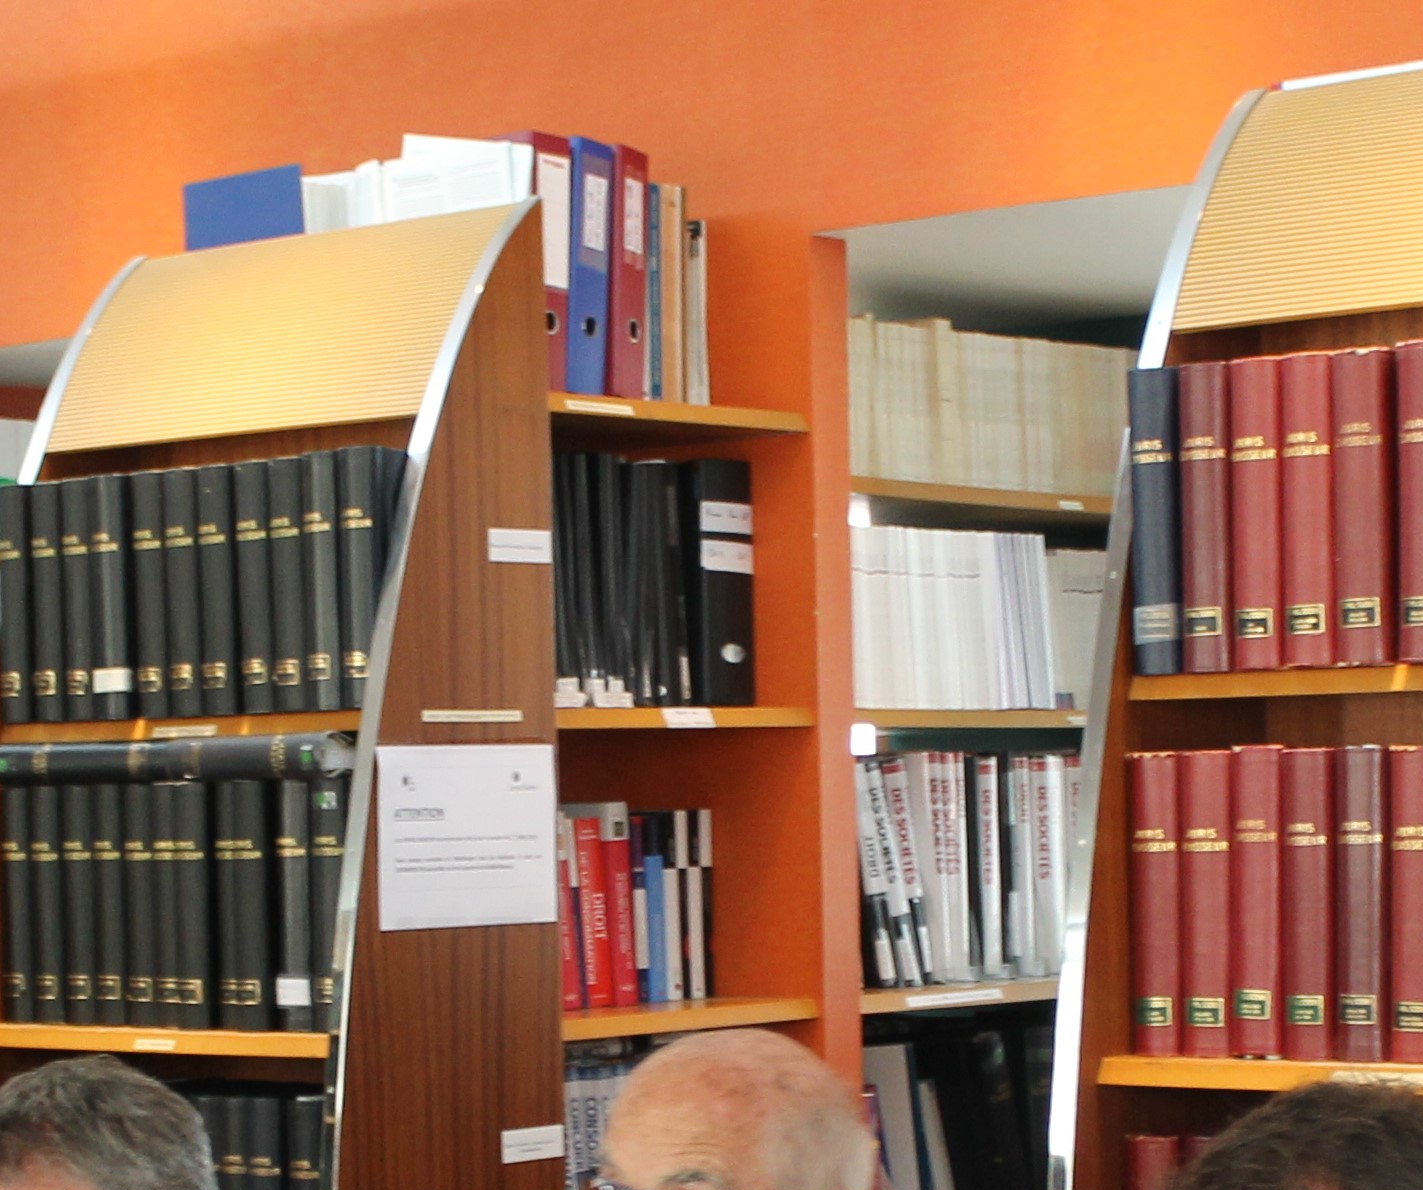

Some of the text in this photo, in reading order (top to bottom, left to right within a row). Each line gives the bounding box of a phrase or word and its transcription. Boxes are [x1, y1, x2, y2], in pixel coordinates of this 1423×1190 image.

[891, 787, 904, 816] DES
[1038, 786, 1048, 812] DES
[592, 893, 608, 939] DROIT
